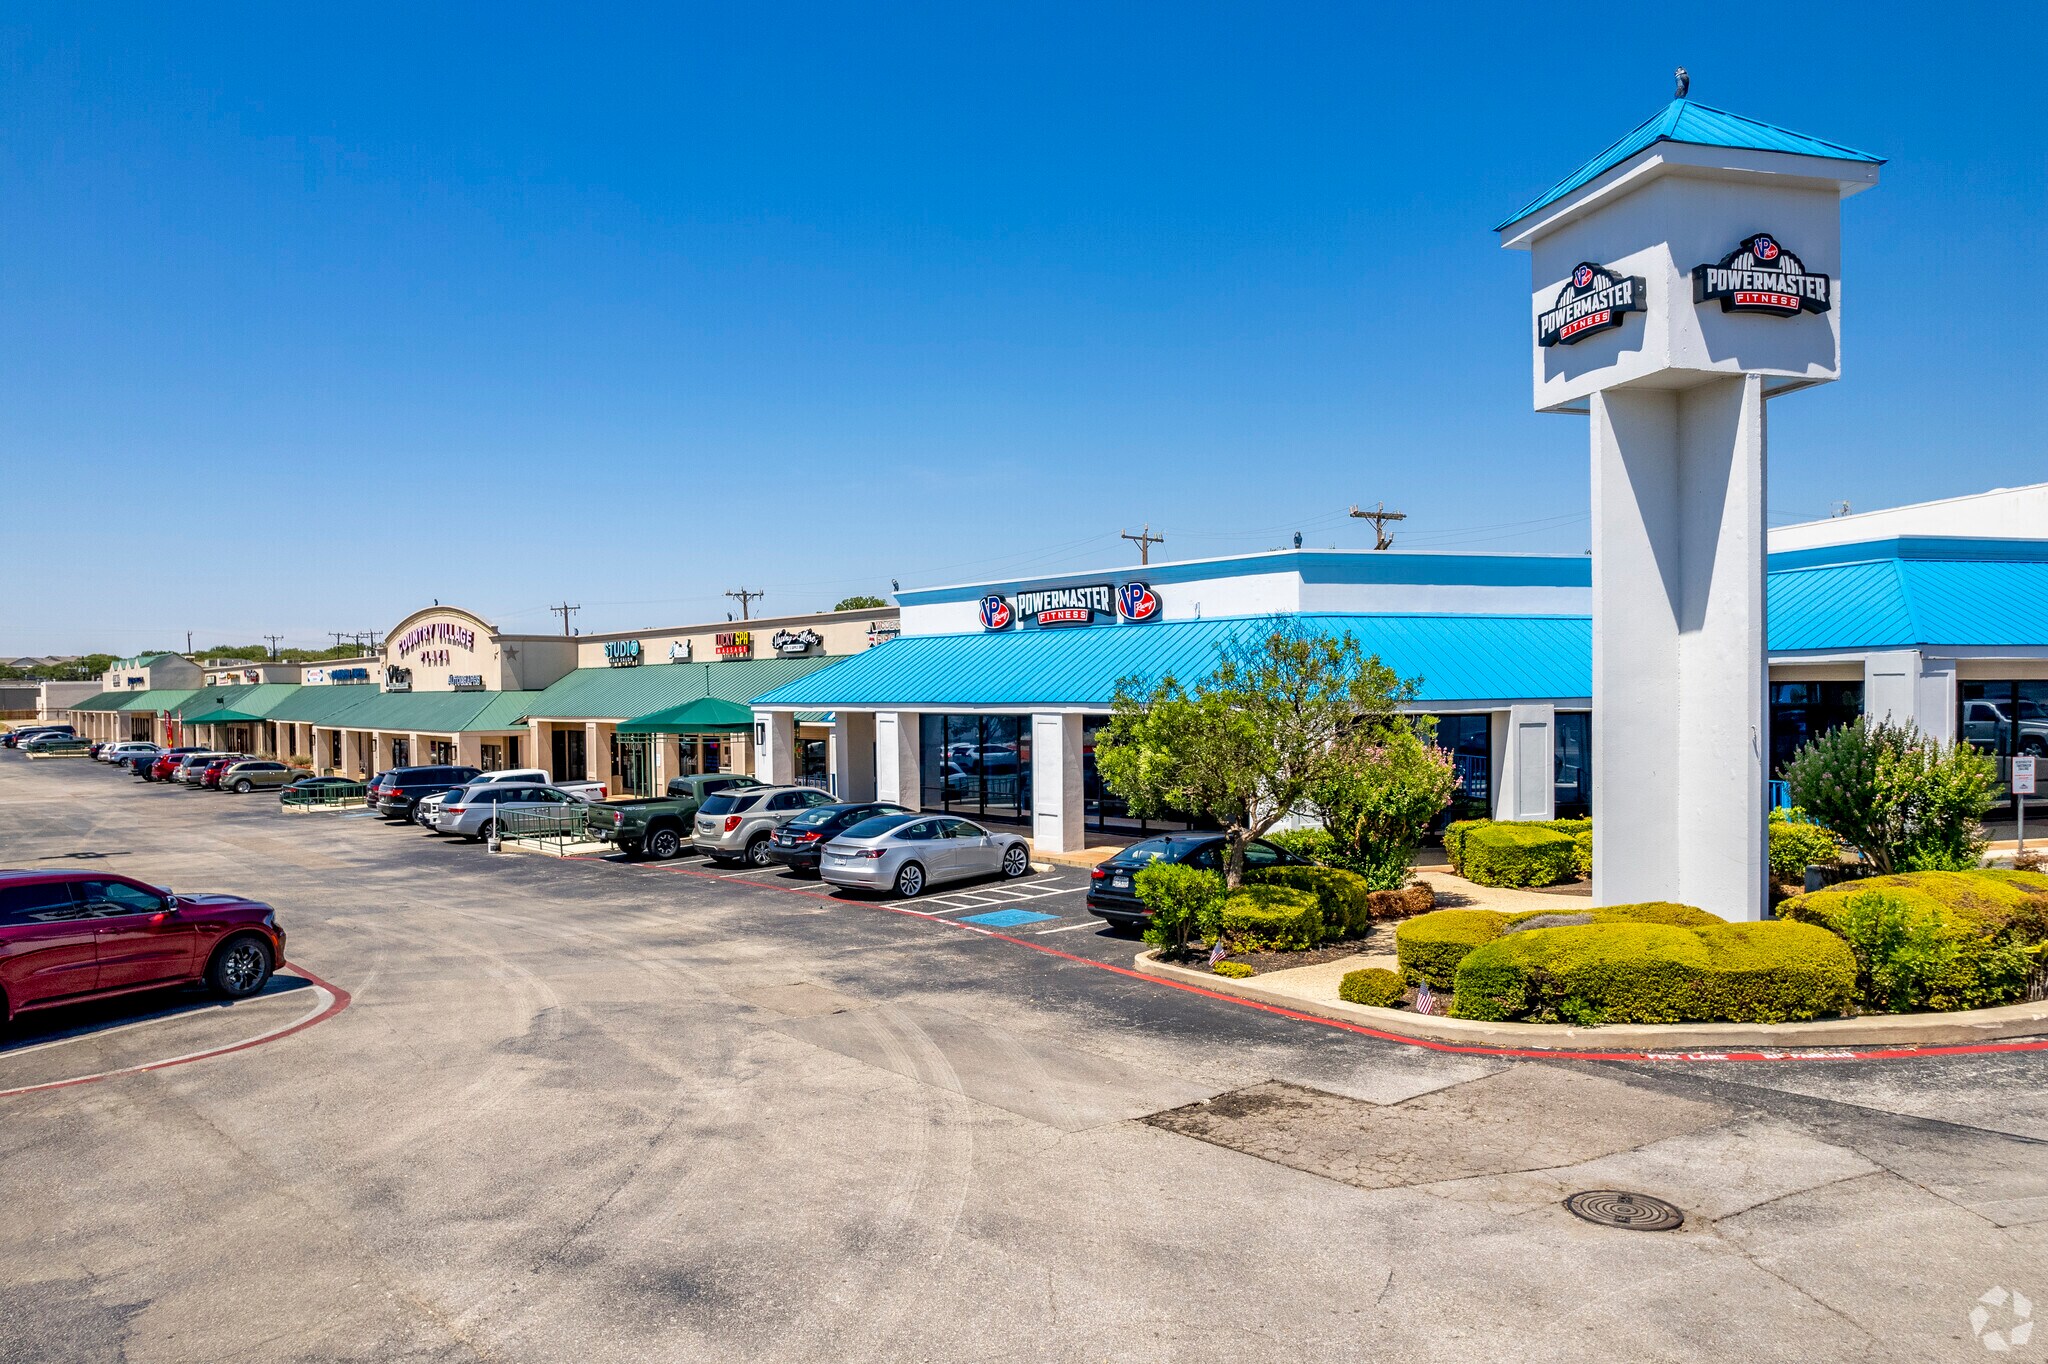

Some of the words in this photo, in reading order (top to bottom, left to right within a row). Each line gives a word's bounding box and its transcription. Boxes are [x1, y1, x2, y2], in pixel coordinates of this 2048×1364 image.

[1755, 237, 1771, 259] VP
[1707, 268, 1826, 302] POWERMASTER
[1541, 281, 1632, 339] POWERMASTER
[1737, 294, 1797, 306] FITNESS
[1562, 312, 1608, 337] FITNESS
[981, 596, 1000, 627] VP
[1018, 586, 1109, 618] POWERMASTER
[1120, 583, 1145, 618] VP
[1040, 611, 1086, 622] FITNESS
[397, 624, 435, 654] COUNTRY
[436, 623, 474, 647] VILLAGE
[716, 633, 733, 646] LUCKY
[735, 632, 748, 645] SPA
[716, 646, 747, 654] MASSAGE
[421, 650, 449, 661] PLAZA
